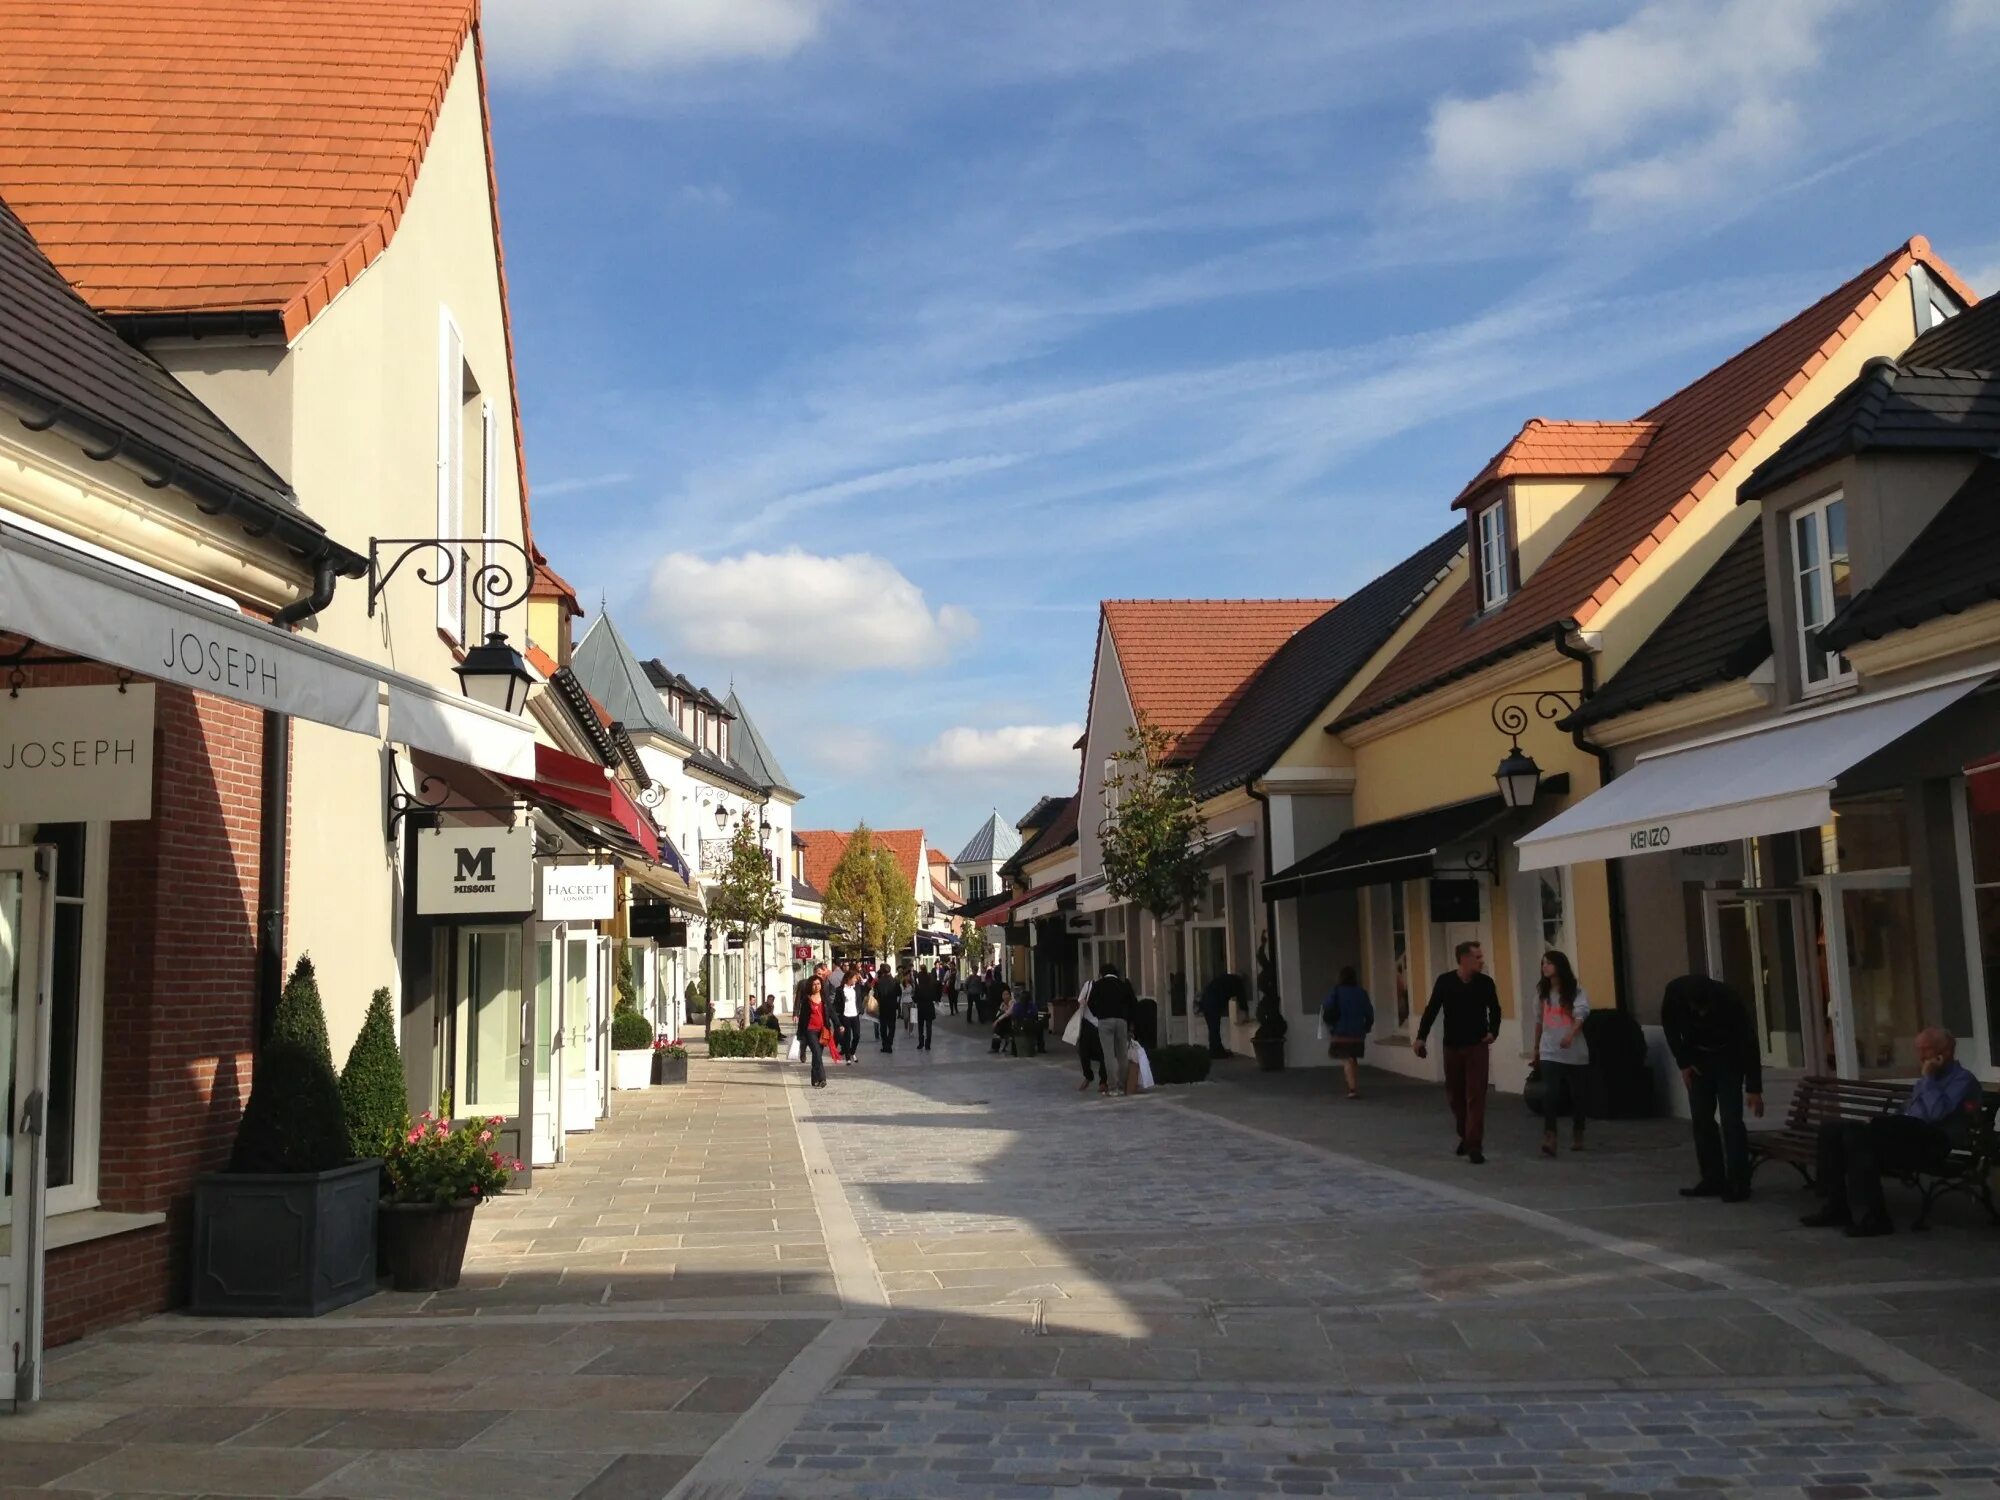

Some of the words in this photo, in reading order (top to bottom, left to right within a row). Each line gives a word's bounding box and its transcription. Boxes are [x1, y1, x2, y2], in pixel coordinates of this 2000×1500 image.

[163, 628, 279, 699] JOSEPH
[3, 739, 135, 770] JOSEPH
[1630, 826, 1670, 850] KENZO
[454, 847, 495, 881] M
[454, 885, 495, 893] MISSONI
[548, 884, 608, 895] HACKETT
